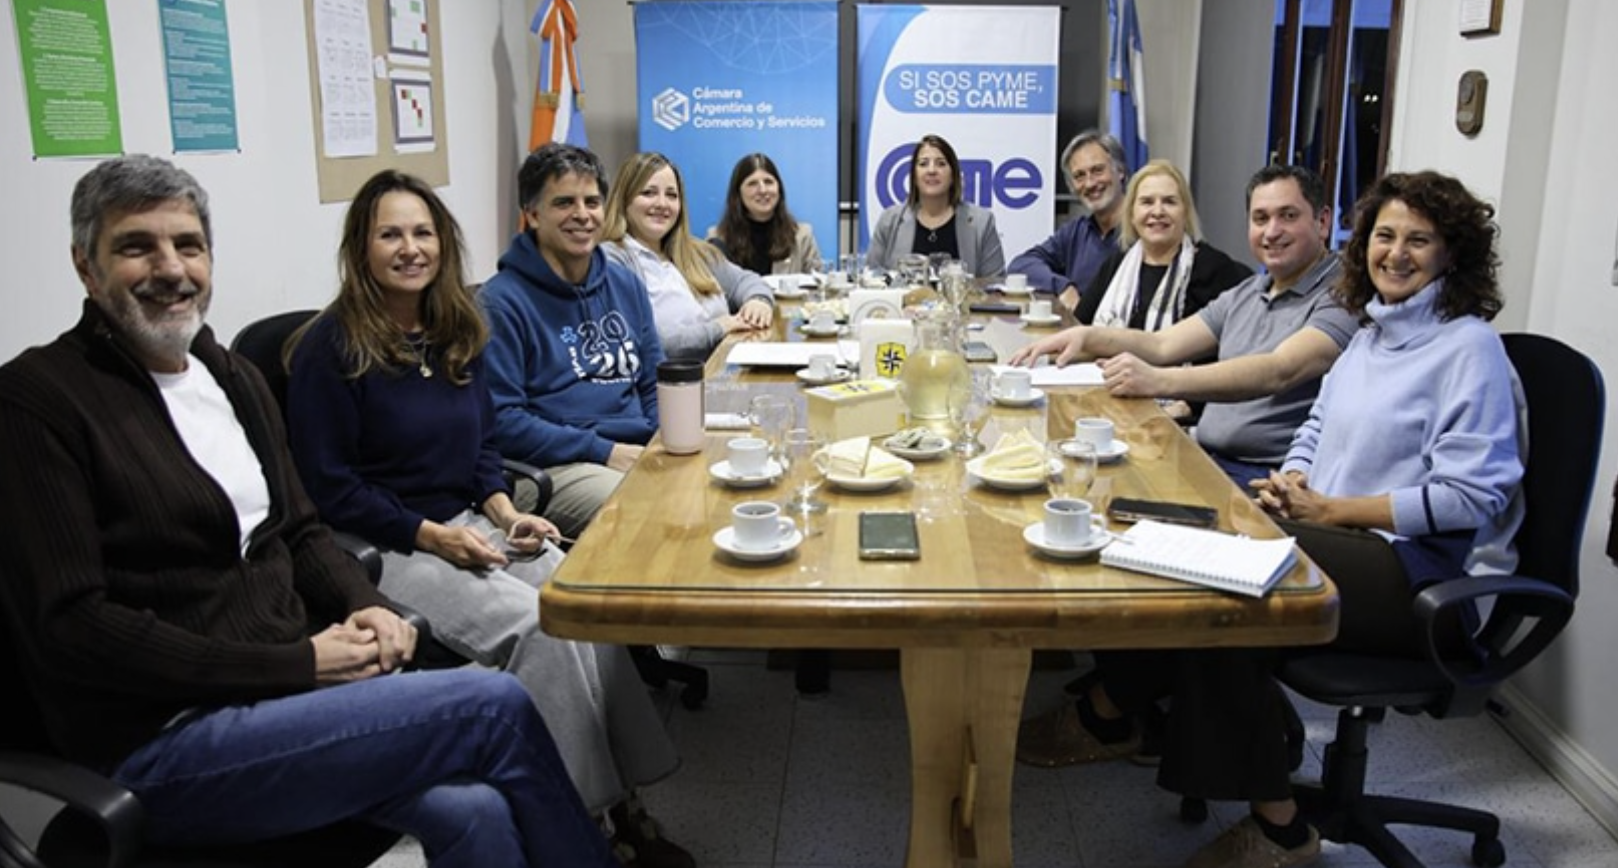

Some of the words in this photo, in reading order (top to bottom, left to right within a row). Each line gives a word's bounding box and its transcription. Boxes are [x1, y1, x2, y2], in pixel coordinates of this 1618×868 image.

[899, 70, 921, 90] SI
[926, 70, 972, 90] SOS
[978, 71, 1043, 94] PYME,
[692, 86, 743, 99] Cámara
[914, 89, 960, 108] SOS
[965, 90, 1028, 108] CAME
[692, 102, 753, 116] Argentina
[756, 102, 773, 114] de
[692, 116, 755, 129] Comercio
[757, 118, 766, 130] y
[768, 115, 825, 129] Servicios
